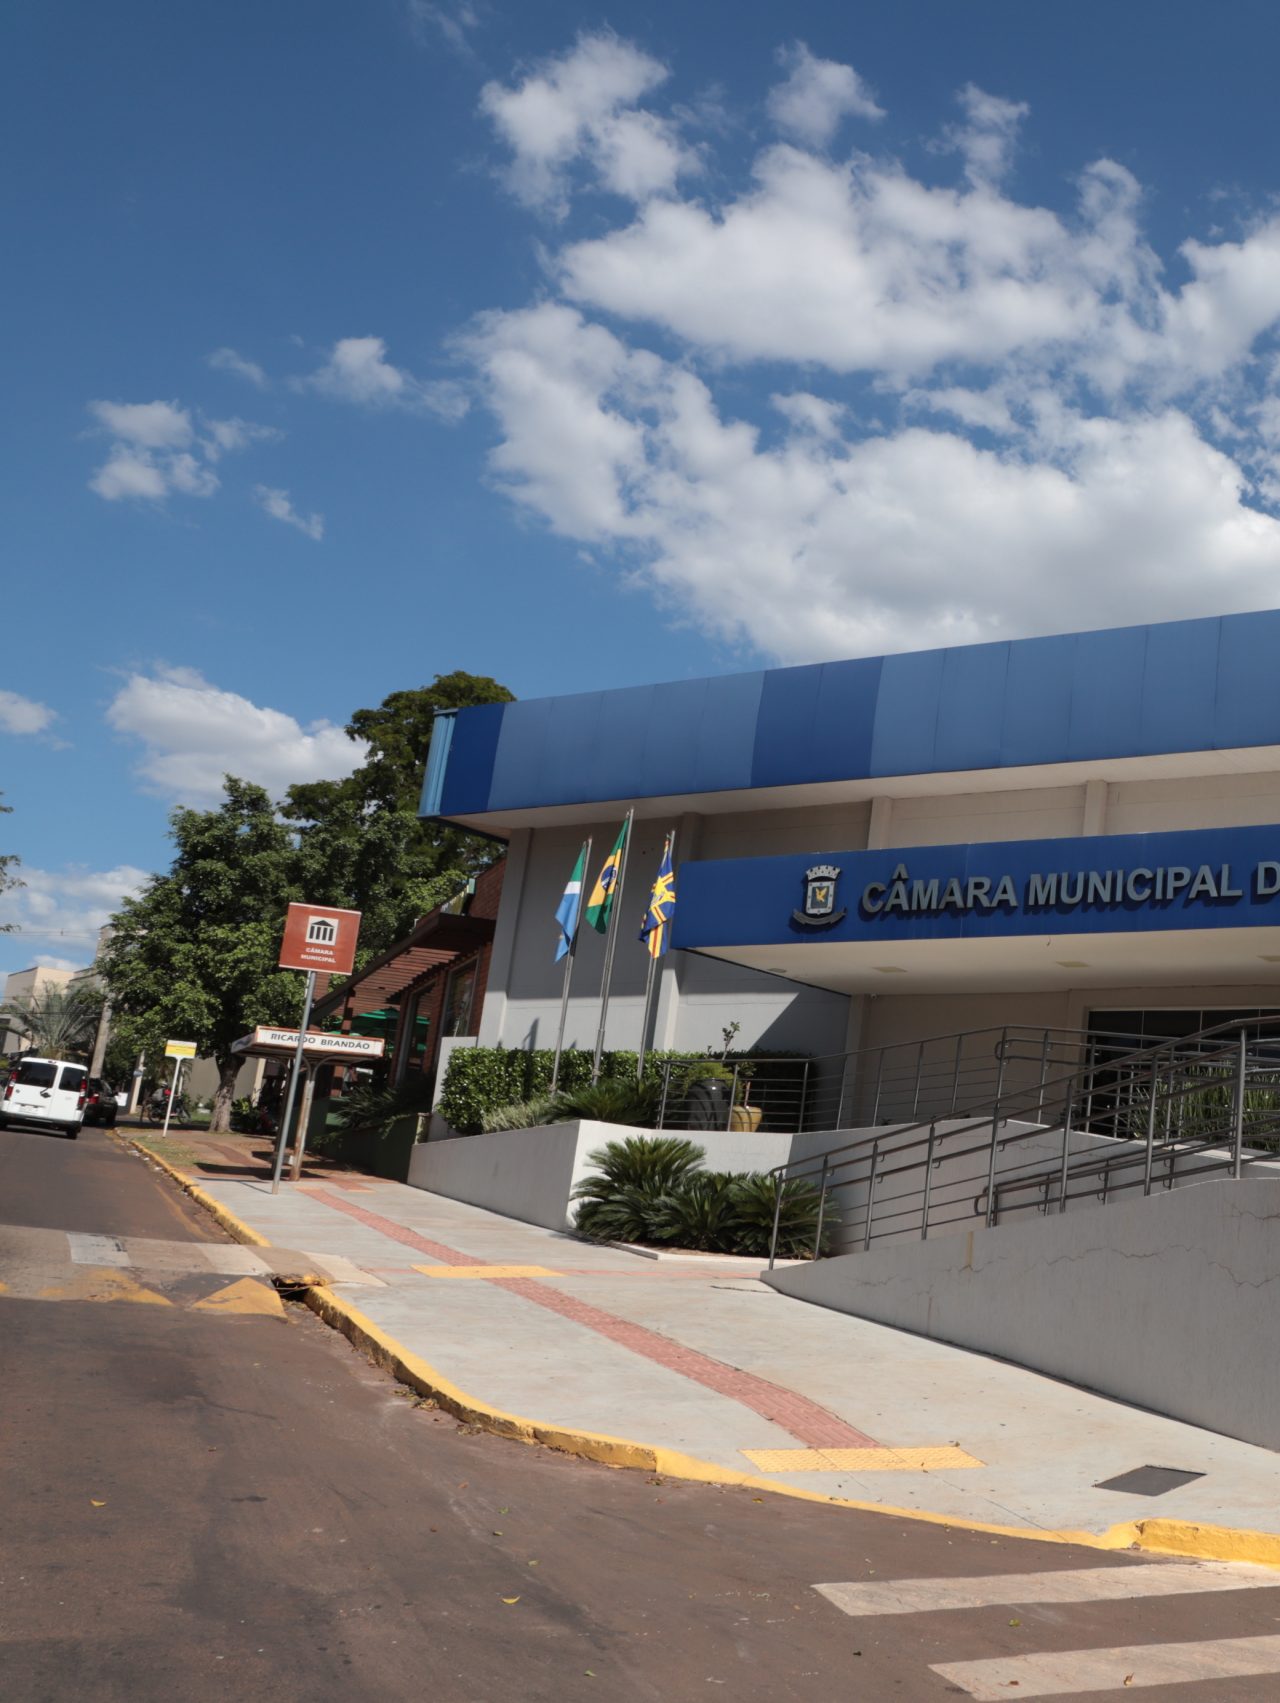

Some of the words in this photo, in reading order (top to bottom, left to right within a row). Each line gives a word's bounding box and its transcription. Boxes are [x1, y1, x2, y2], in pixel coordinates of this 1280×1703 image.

[861, 863, 1018, 913] CÂMARA
[1028, 864, 1243, 906] MUNICIPAL
[305, 947, 333, 955] CÂMARA
[301, 954, 336, 963] MUNICIPAL
